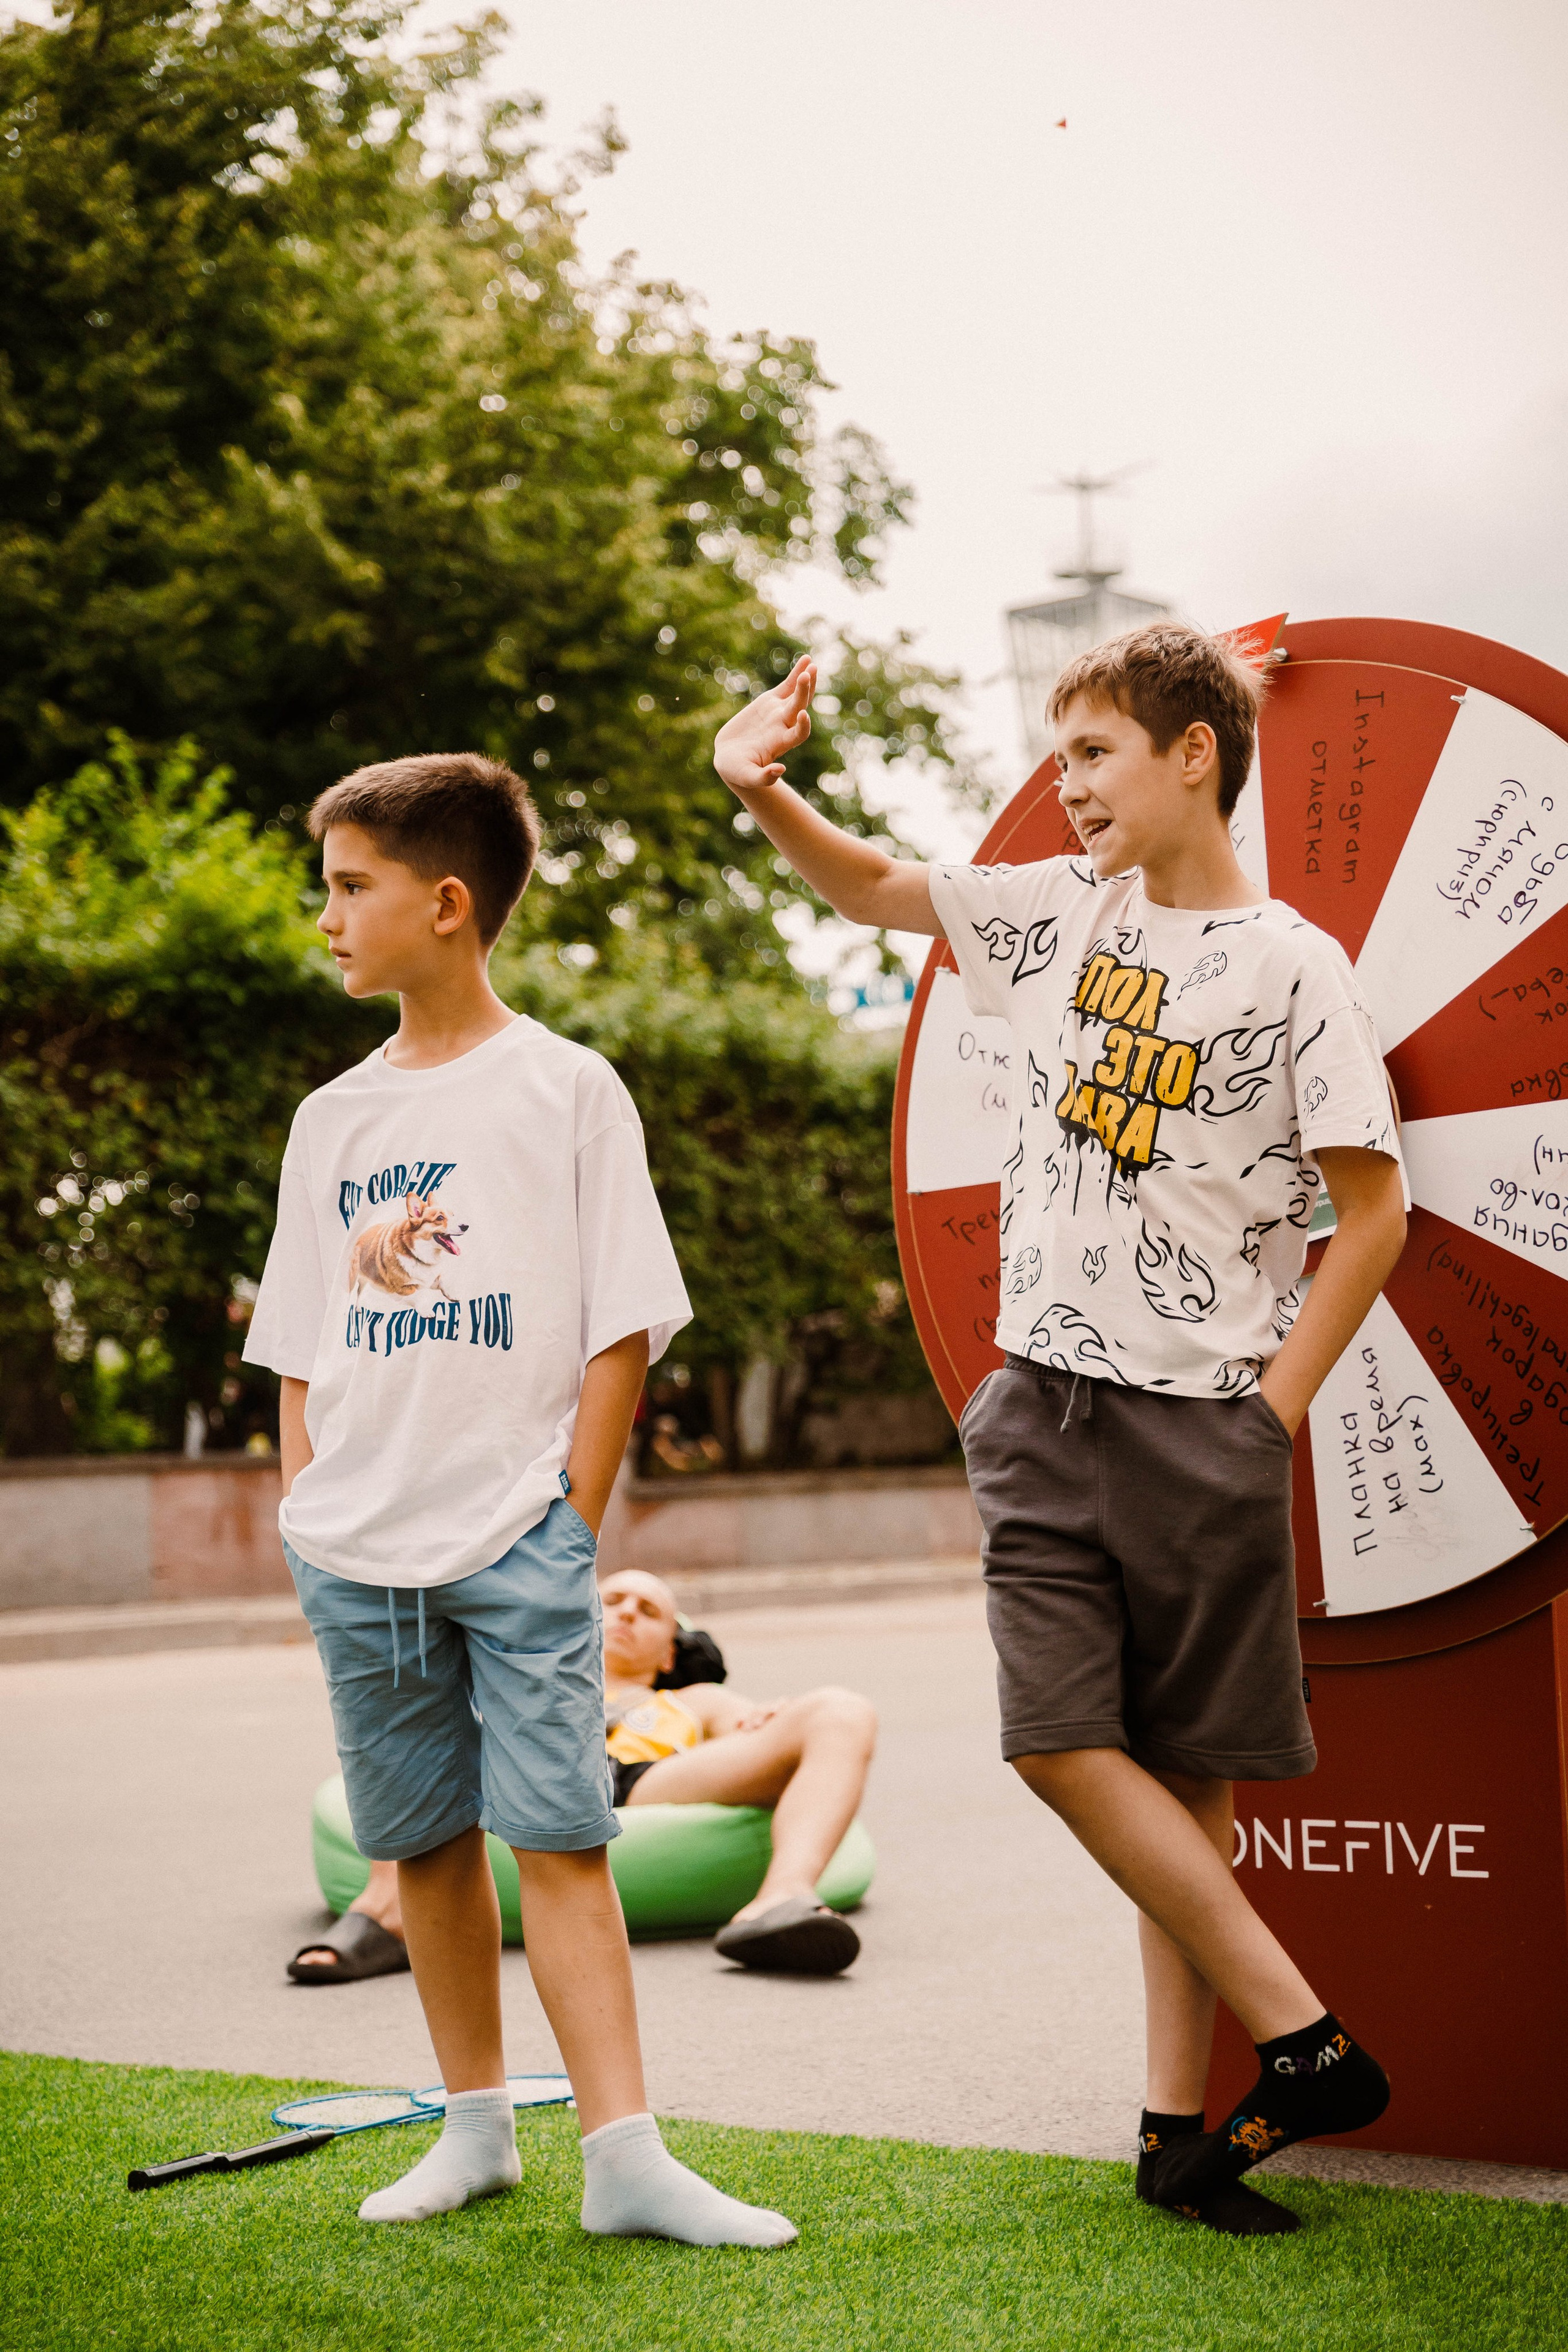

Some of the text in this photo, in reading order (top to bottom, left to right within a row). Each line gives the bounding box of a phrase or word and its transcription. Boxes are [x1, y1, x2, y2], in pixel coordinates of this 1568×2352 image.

[1305, 741, 1327, 874] отметка
[1338, 689, 1384, 884] Instagram
[1075, 952, 1168, 1033] ПОЛ
[1093, 1025, 1199, 1110] ЭТО
[385, 1302, 461, 1357] JUDGE
[469, 1293, 513, 1351] YOU
[1362, 1348, 1409, 1514] на время
[1427, 1325, 1544, 1507] Тренировка
